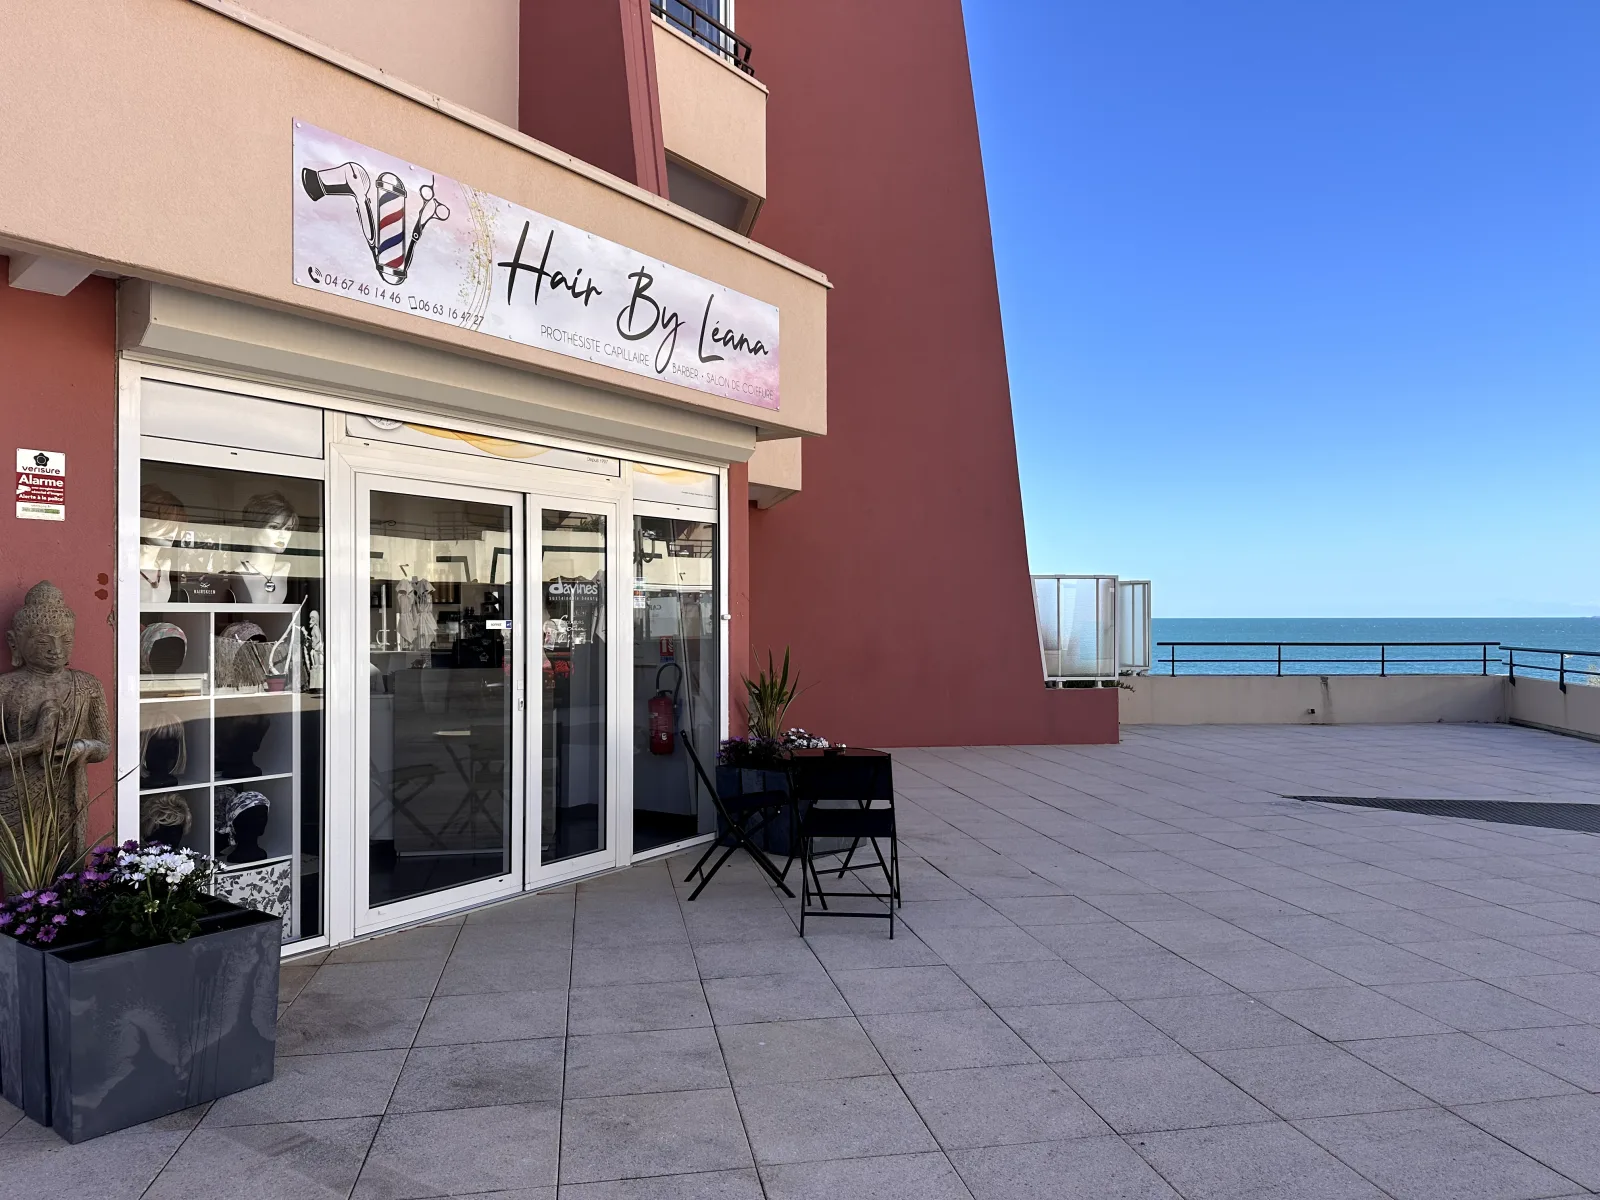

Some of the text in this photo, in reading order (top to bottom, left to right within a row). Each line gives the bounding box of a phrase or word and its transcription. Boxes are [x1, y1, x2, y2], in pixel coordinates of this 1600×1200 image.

[324, 273, 401, 304] 04 67 46 14 46
[497, 220, 769, 374] Hair By Léana
[418, 299, 484, 327] 06 63 16 47 27
[540, 324, 650, 367] PROTHÉSISTE CAPILLAIRE
[672, 362, 699, 380] BARBER
[706, 372, 730, 389] SALON
[731, 380, 740, 392] DE
[19, 474, 64, 486] Alarme
[22, 466, 60, 474] verisure
[548, 576, 598, 595] davines
